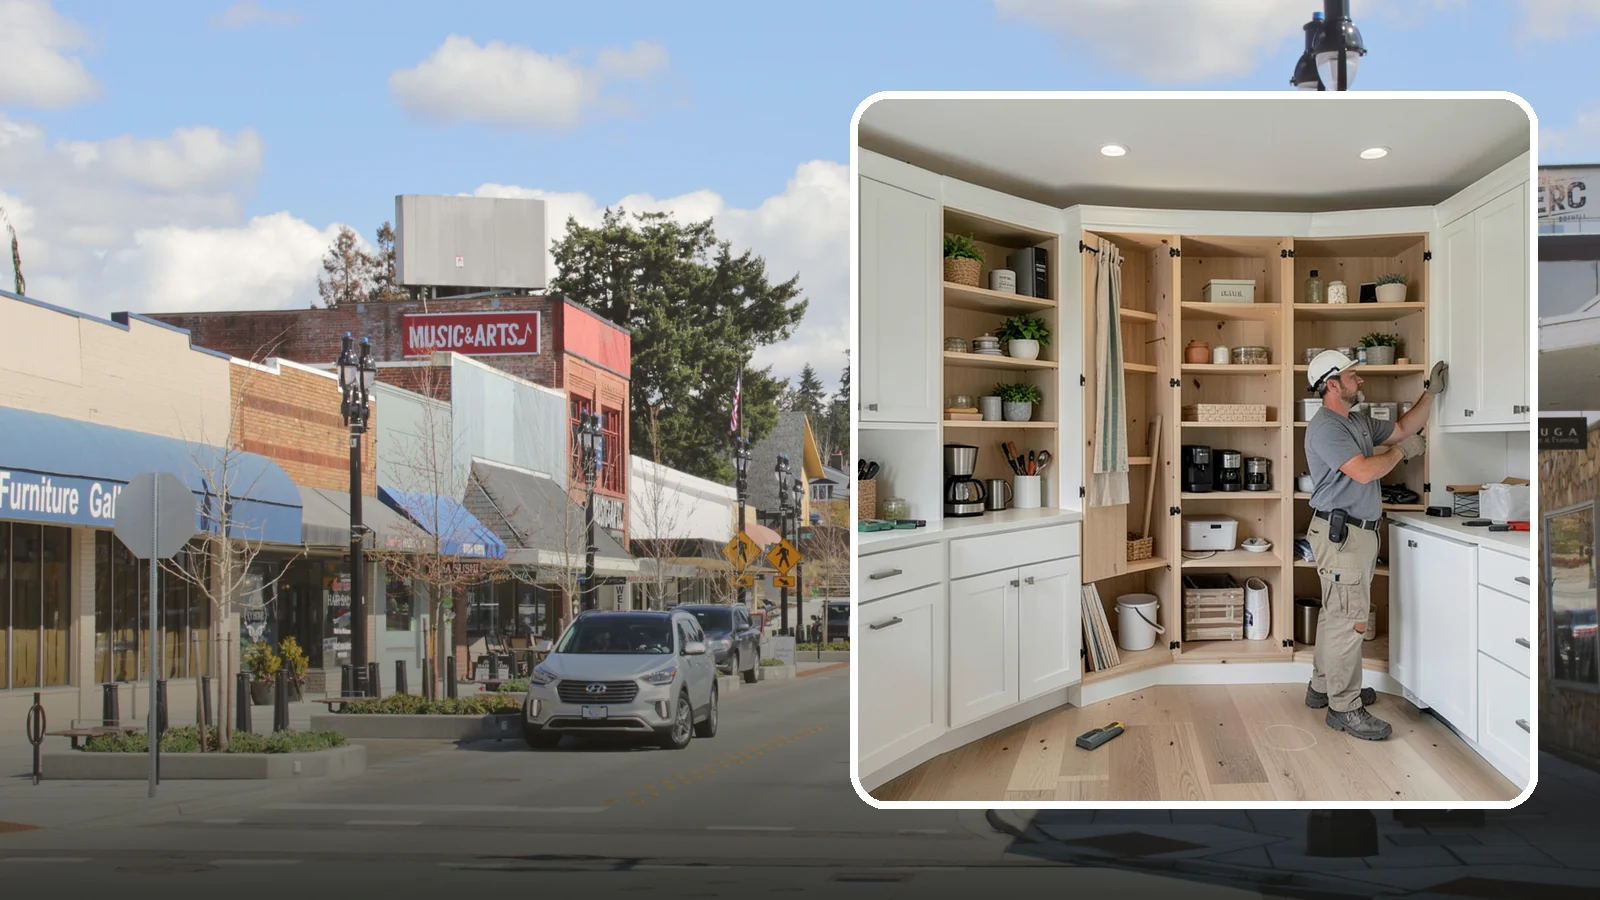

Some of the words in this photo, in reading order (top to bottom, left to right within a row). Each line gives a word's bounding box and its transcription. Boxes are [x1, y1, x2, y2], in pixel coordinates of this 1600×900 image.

[408, 322, 520, 349] MUSIC&ARTS
[1540, 427, 1578, 436] UGA
[0, 471, 79, 516] Furniture
[89, 481, 121, 519] Gal
[453, 564, 479, 574] SUSHI
